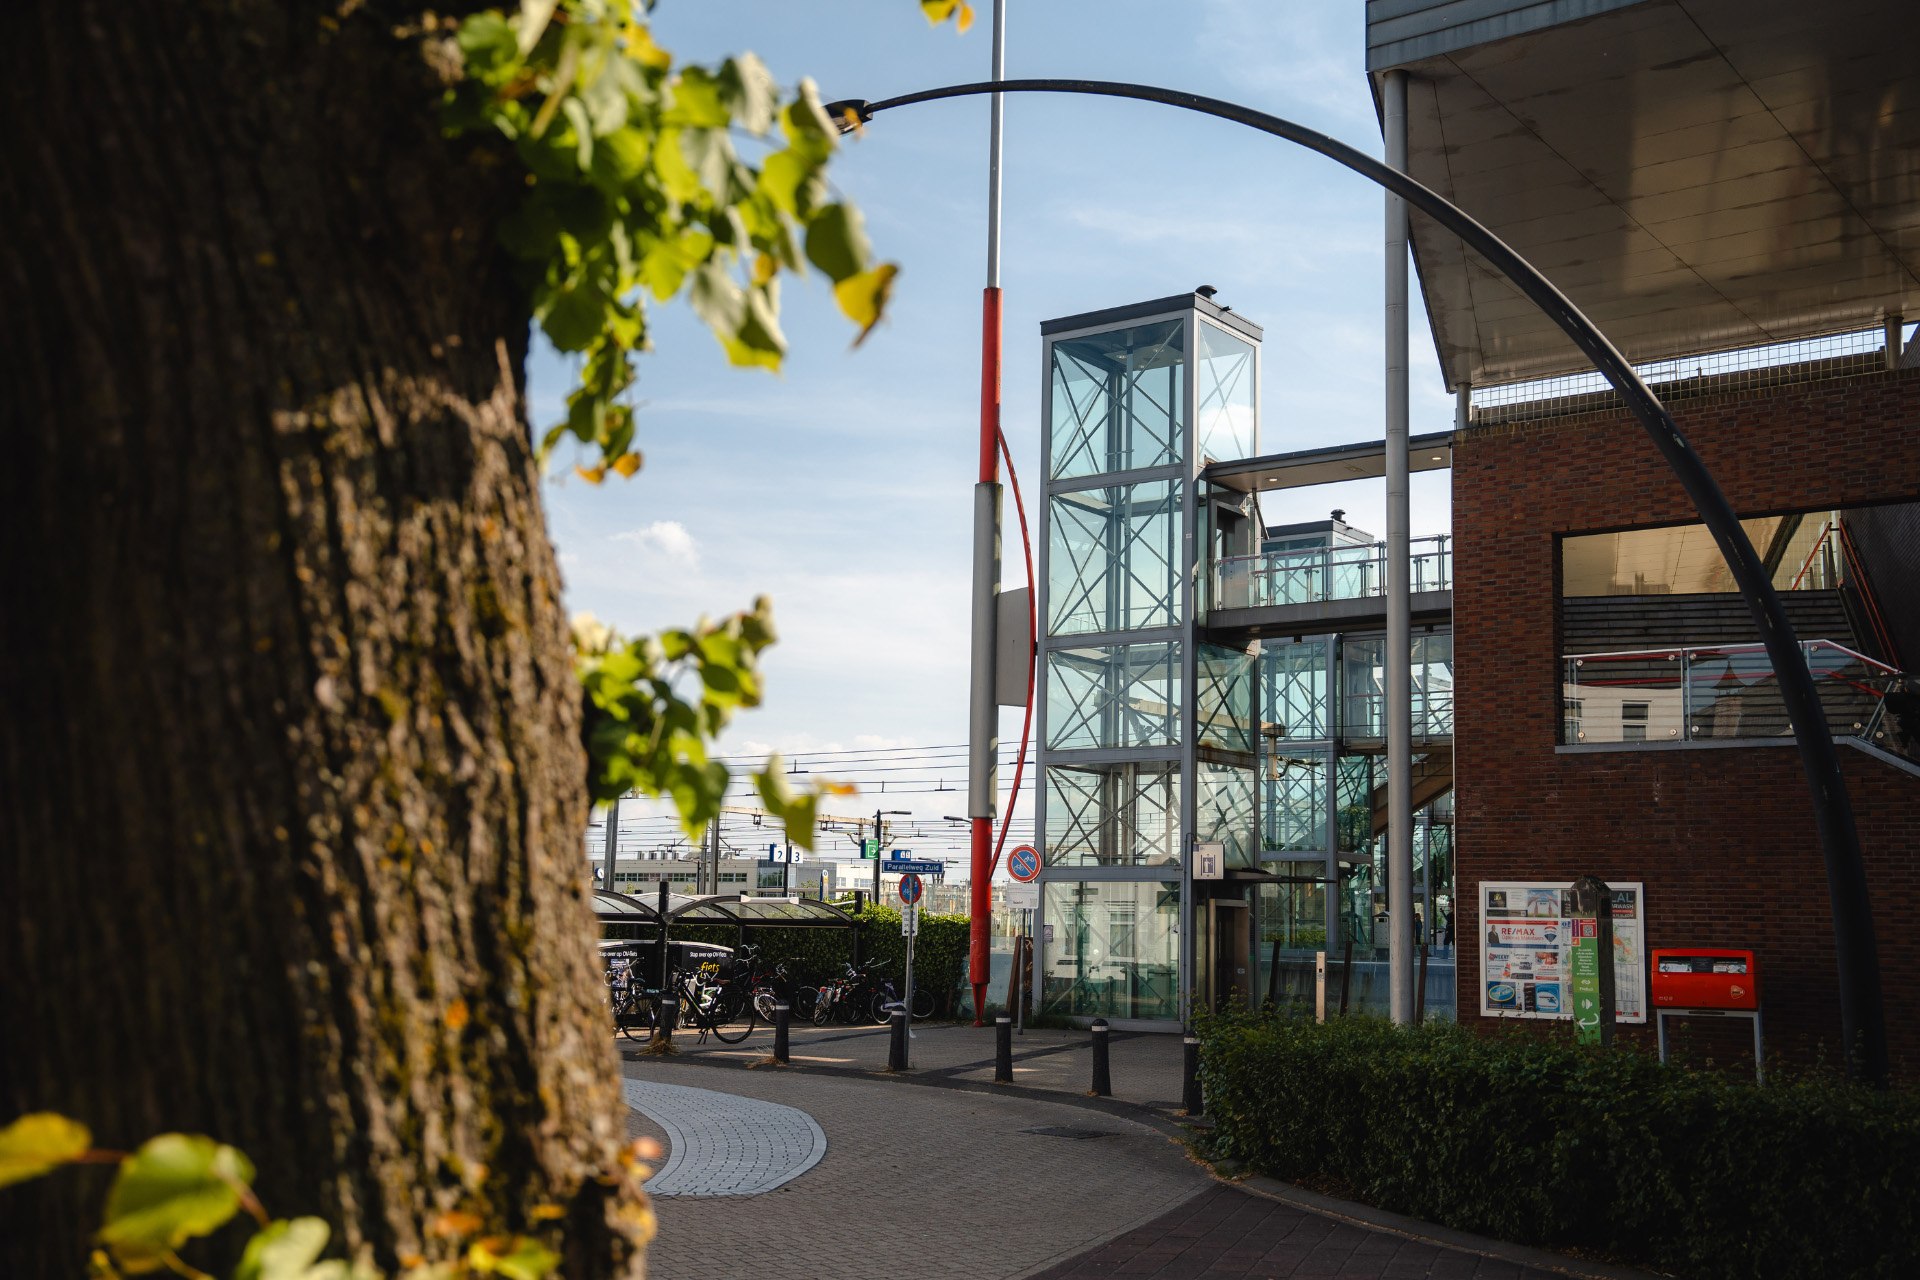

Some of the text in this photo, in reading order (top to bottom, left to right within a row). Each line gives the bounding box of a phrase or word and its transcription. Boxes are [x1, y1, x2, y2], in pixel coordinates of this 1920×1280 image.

[777, 850, 783, 860] 2
[794, 851, 800, 862] 3
[887, 863, 924, 872] Parallelweg
[1501, 927, 1536, 936] RE/MAX
[701, 961, 720, 973] fiets
